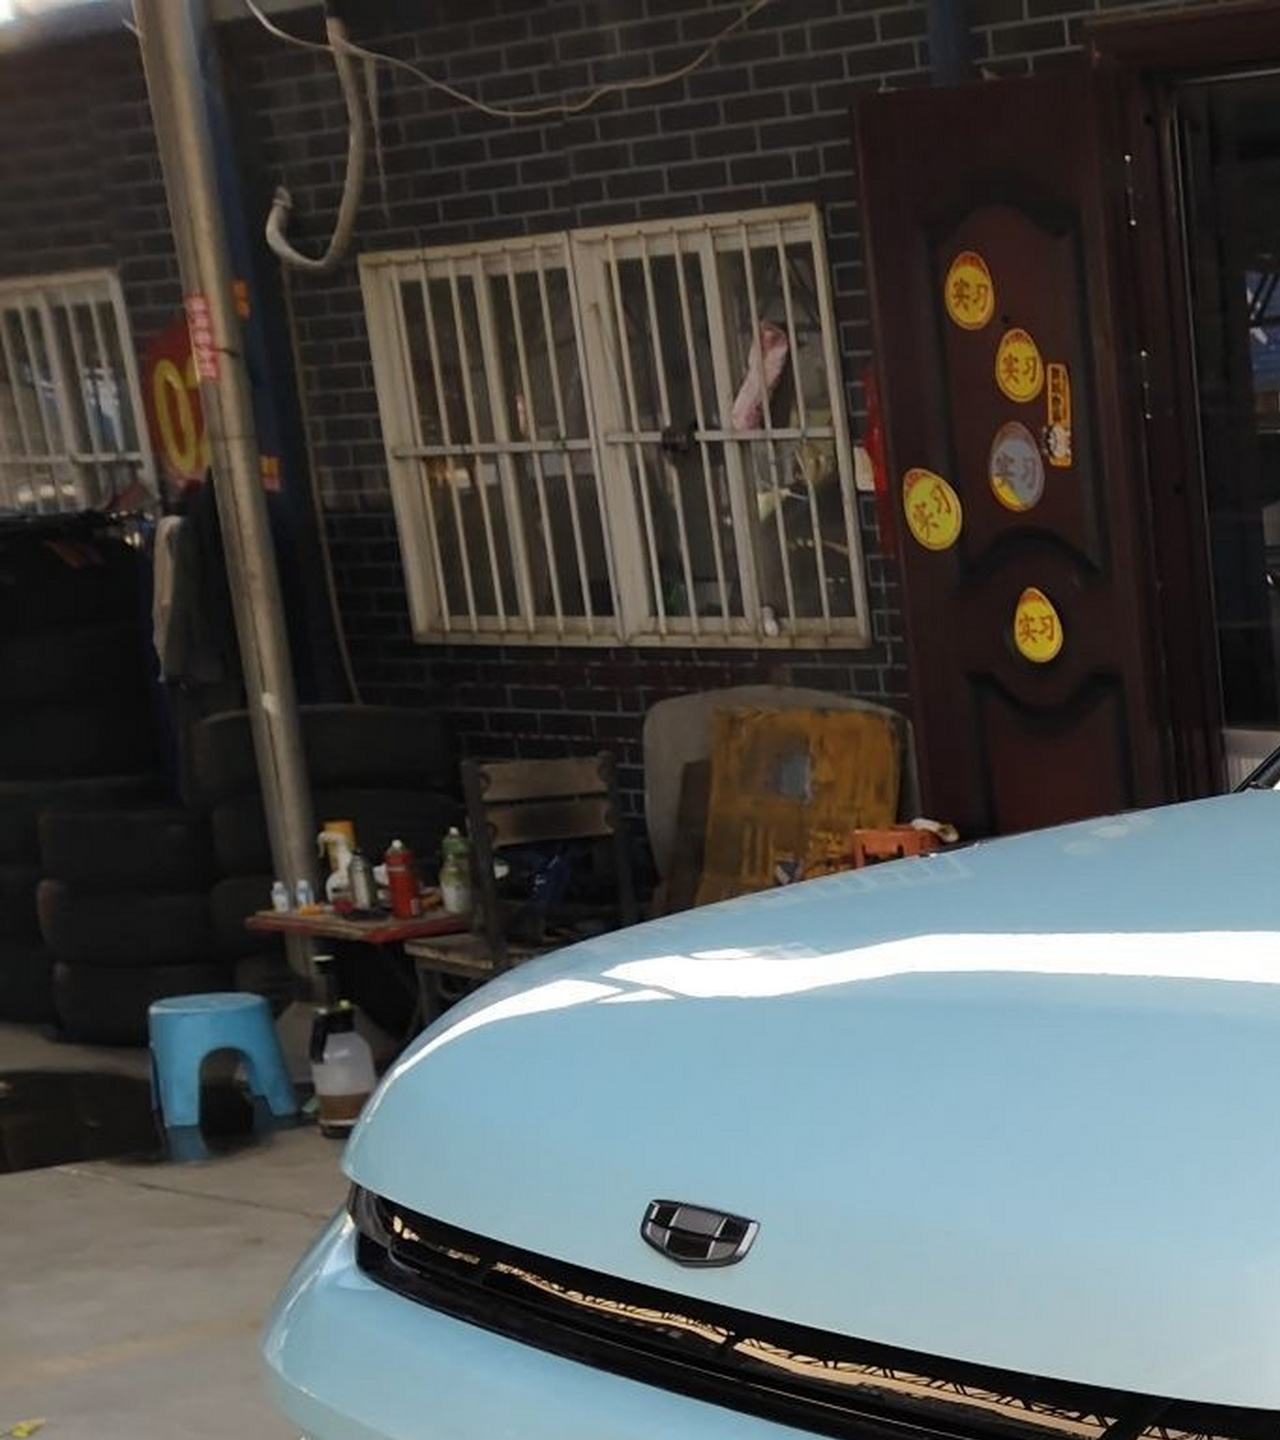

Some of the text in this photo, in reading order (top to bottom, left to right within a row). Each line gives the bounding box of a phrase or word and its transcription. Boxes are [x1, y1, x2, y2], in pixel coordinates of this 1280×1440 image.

[952, 277, 989, 312] 实习
[1001, 352, 1037, 384] 实习
[913, 483, 951, 540] 实习
[1018, 614, 1055, 643] 实习
